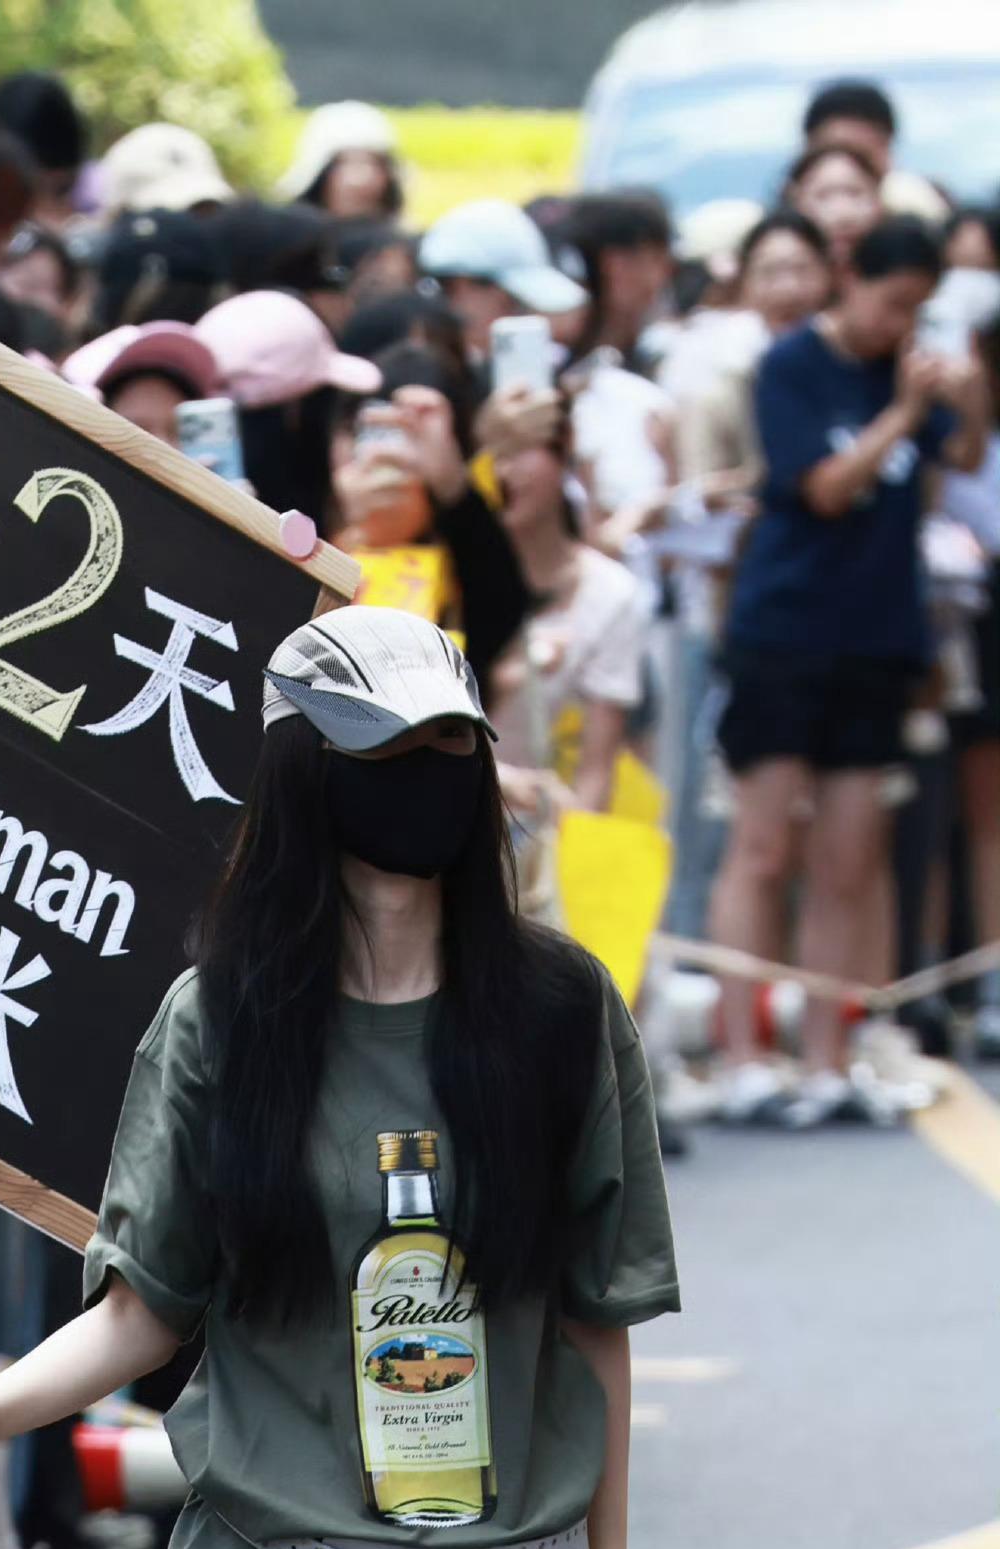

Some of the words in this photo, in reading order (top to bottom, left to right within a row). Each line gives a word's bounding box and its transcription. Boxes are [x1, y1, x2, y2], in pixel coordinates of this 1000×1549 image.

[434, 1401, 470, 1409] QUALITY
[382, 1414, 419, 1425] Extra
[424, 1410, 463, 1425] Virgin
